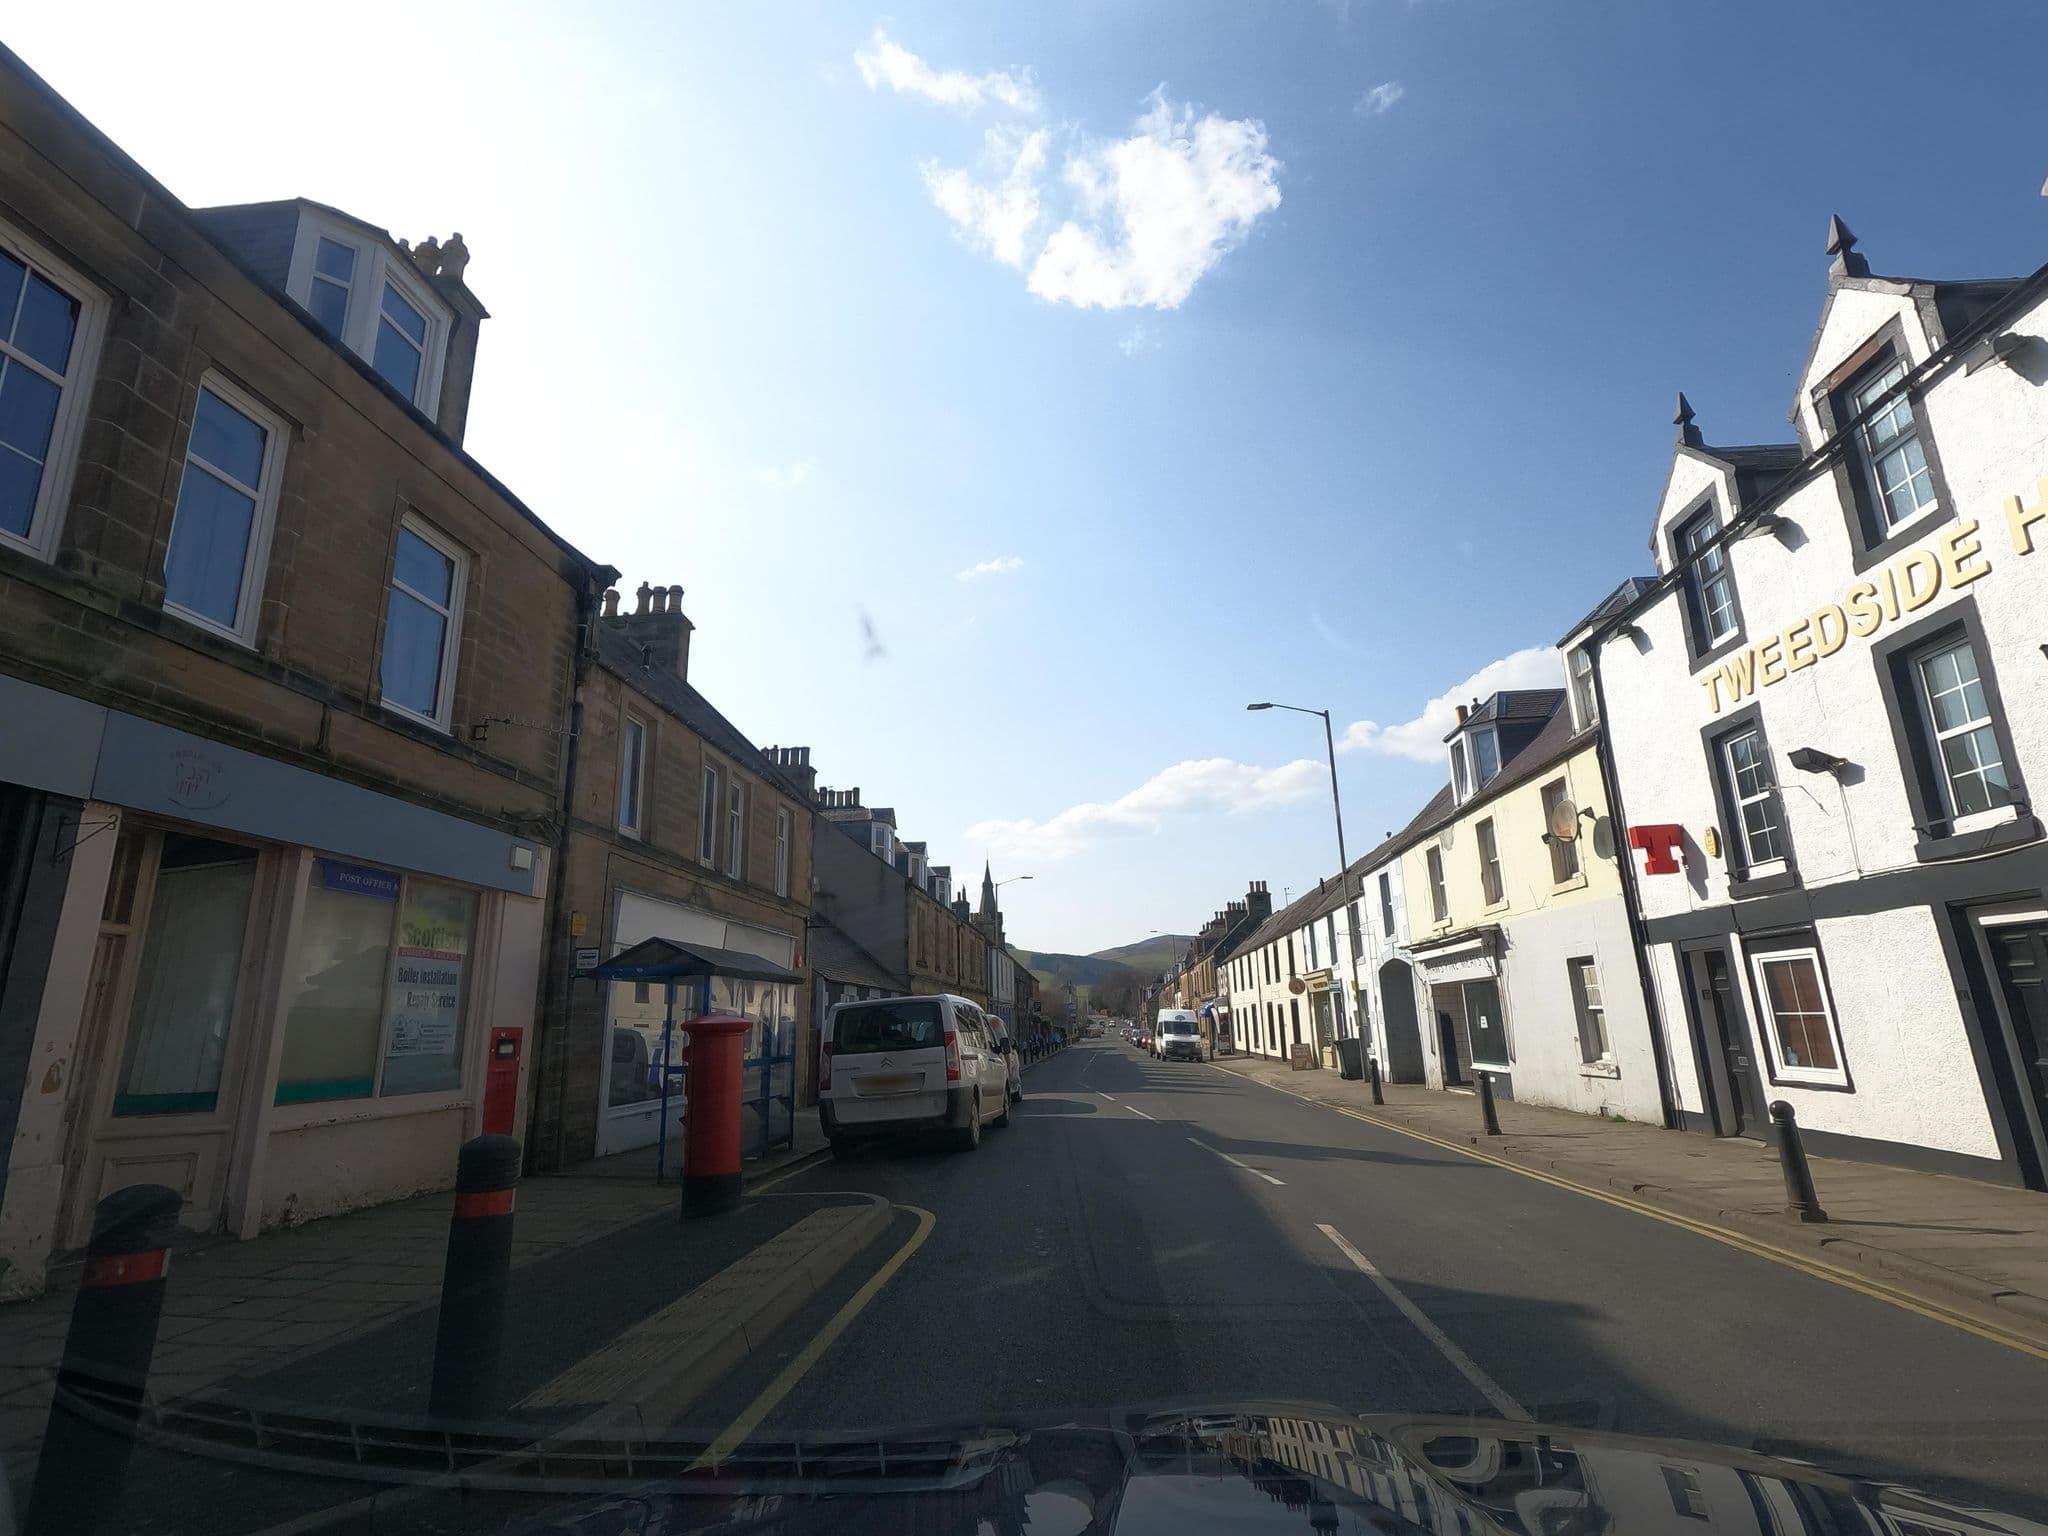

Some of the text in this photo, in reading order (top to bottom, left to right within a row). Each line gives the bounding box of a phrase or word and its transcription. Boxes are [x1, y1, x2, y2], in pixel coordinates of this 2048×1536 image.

[1699, 519, 1992, 714] TWEEDSIDE
[1629, 823, 1682, 875] T
[339, 872, 393, 890] POST OFFICE
[397, 967, 458, 985] Boiler Installation
[431, 992, 457, 1008] Service
